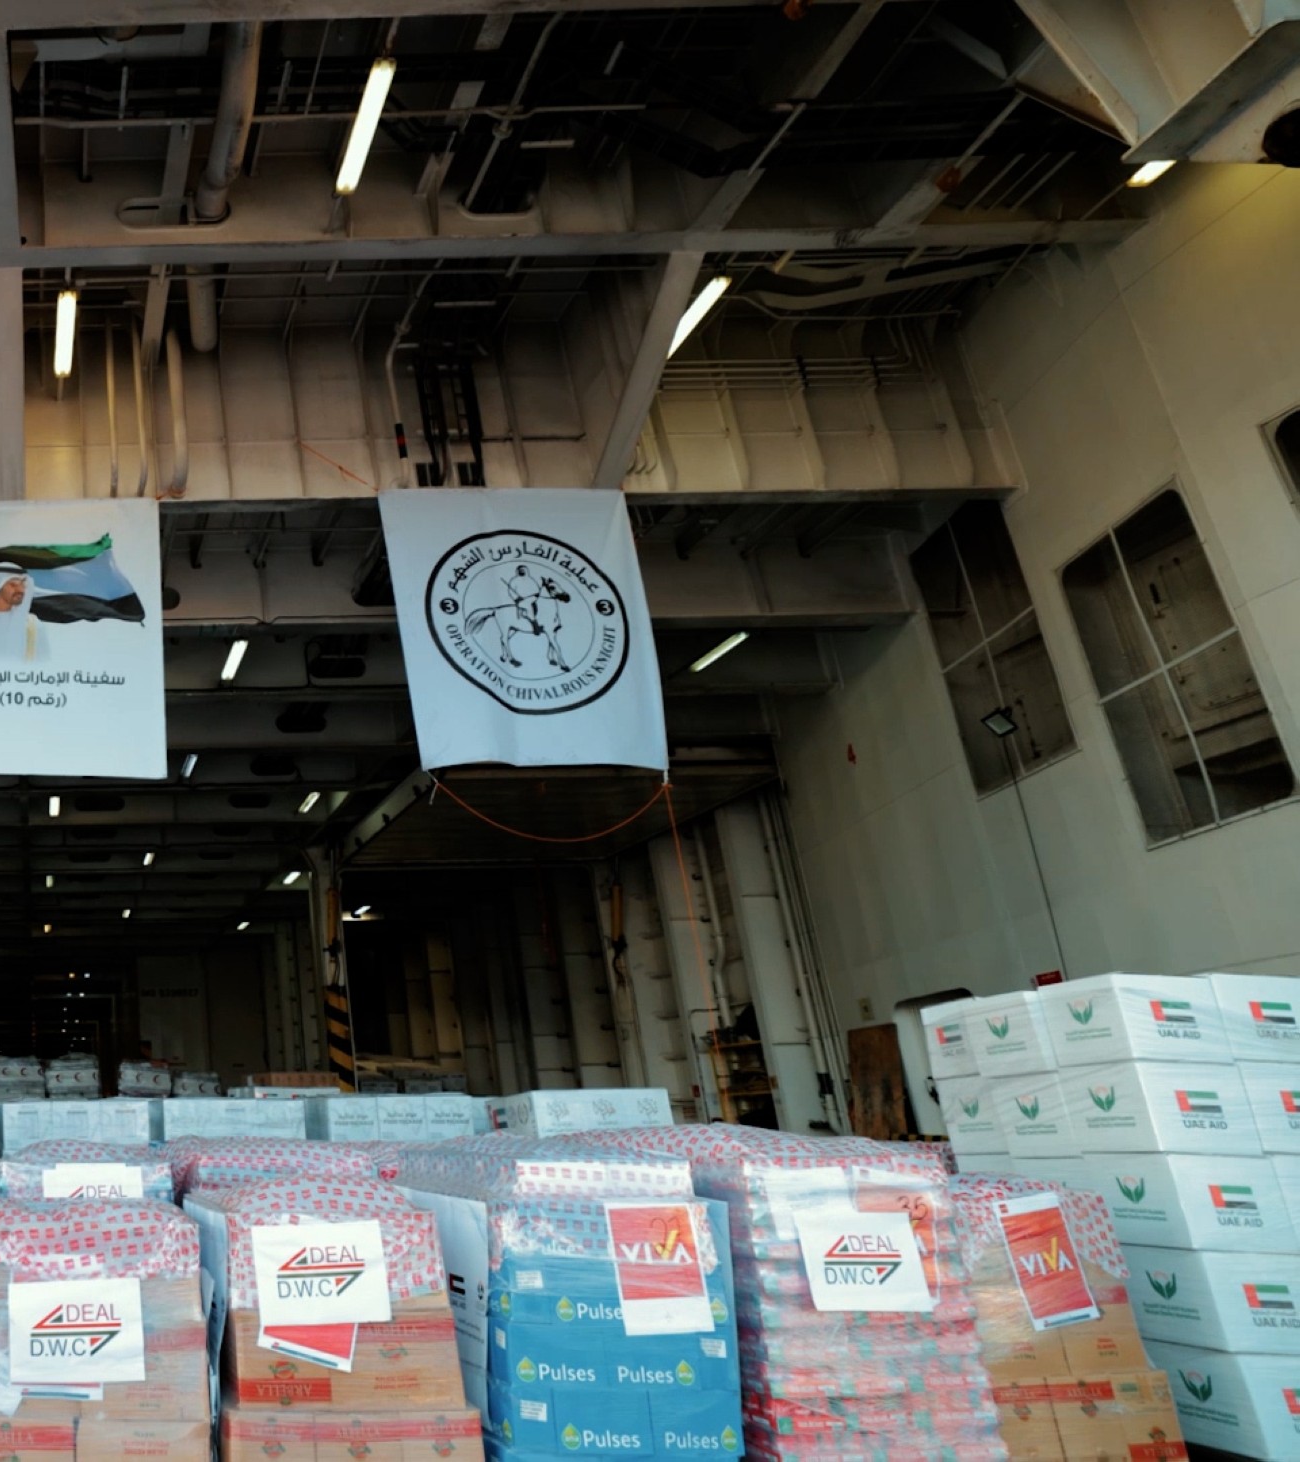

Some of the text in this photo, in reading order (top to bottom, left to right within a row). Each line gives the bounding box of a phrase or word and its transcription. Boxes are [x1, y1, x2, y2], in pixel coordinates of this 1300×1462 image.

[447, 541, 600, 594] عملية الفارس الشهم
[445, 623, 616, 701] OPERATION CHIVALROUS KNIGHT
[14, 670, 70, 686] الإمارات
[73, 670, 125, 687] سفينة
[1157, 1029, 1202, 1039] UAE AID
[1183, 1119, 1228, 1130] UAE AID
[1217, 1216, 1264, 1228] UAE AID
[619, 1230, 694, 1264] VIVA
[1019, 1236, 1074, 1277] VIVA
[823, 1266, 875, 1286] D.W.C
[277, 1278, 333, 1299] D.W.C
[576, 1302, 624, 1320] Pulse
[30, 1338, 87, 1357] D.W.C
[538, 1363, 597, 1382] Pulses
[617, 1365, 675, 1384] Pulses
[582, 1430, 641, 1448] Pulses
[664, 1431, 720, 1449] Pulses
